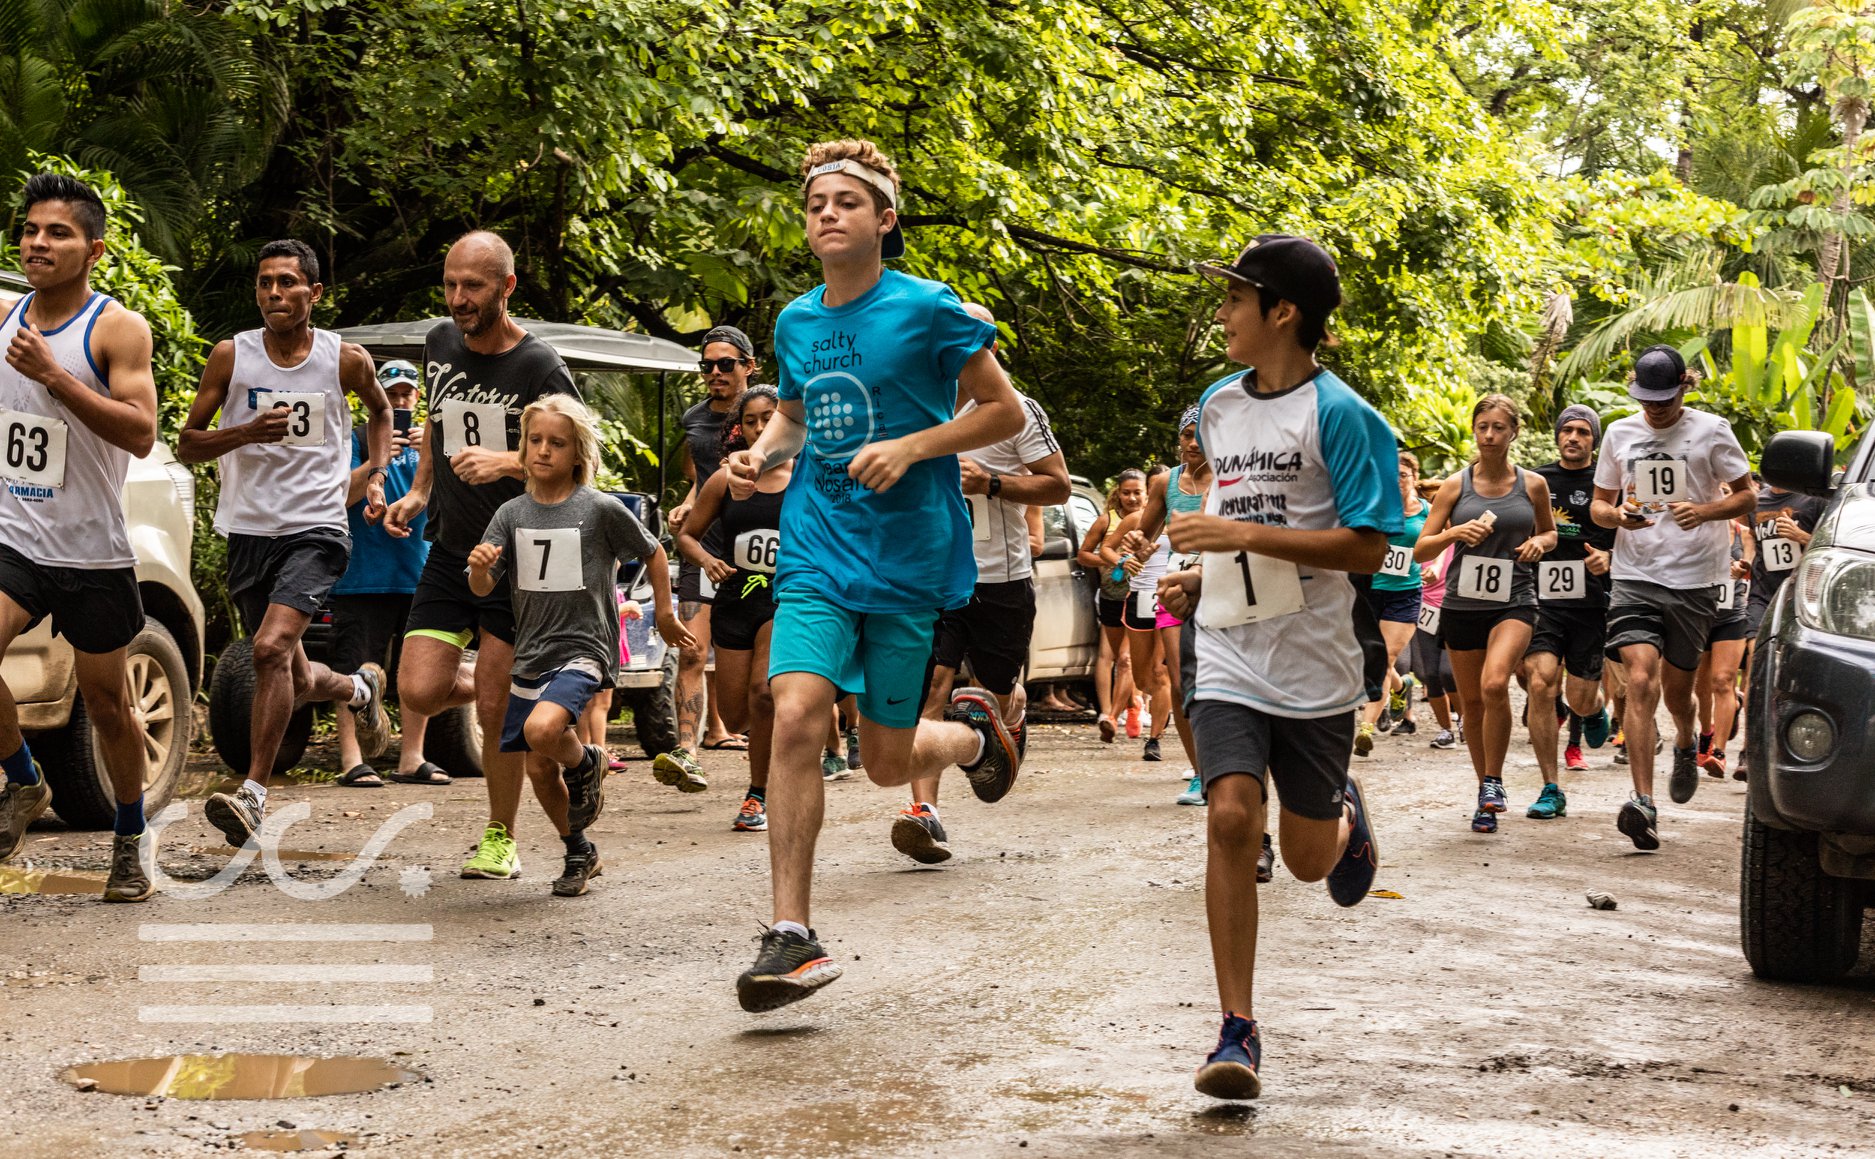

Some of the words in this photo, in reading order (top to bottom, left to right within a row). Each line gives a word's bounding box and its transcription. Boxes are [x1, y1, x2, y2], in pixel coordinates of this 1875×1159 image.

[811, 331, 856, 352] salty
[803, 347, 863, 374] church
[272, 401, 310, 437] 3
[463, 411, 481, 447] 8
[7, 422, 49, 472] 63
[1649, 467, 1674, 495] 19
[533, 539, 551, 581] 7
[747, 534, 780, 567] 66
[1385, 550, 1405, 570] 30
[1772, 543, 1793, 565] 13
[1235, 550, 1257, 607] 1
[1475, 563, 1501, 593] 18
[1549, 567, 1574, 592] 29
[1419, 607, 1435, 627] 27
